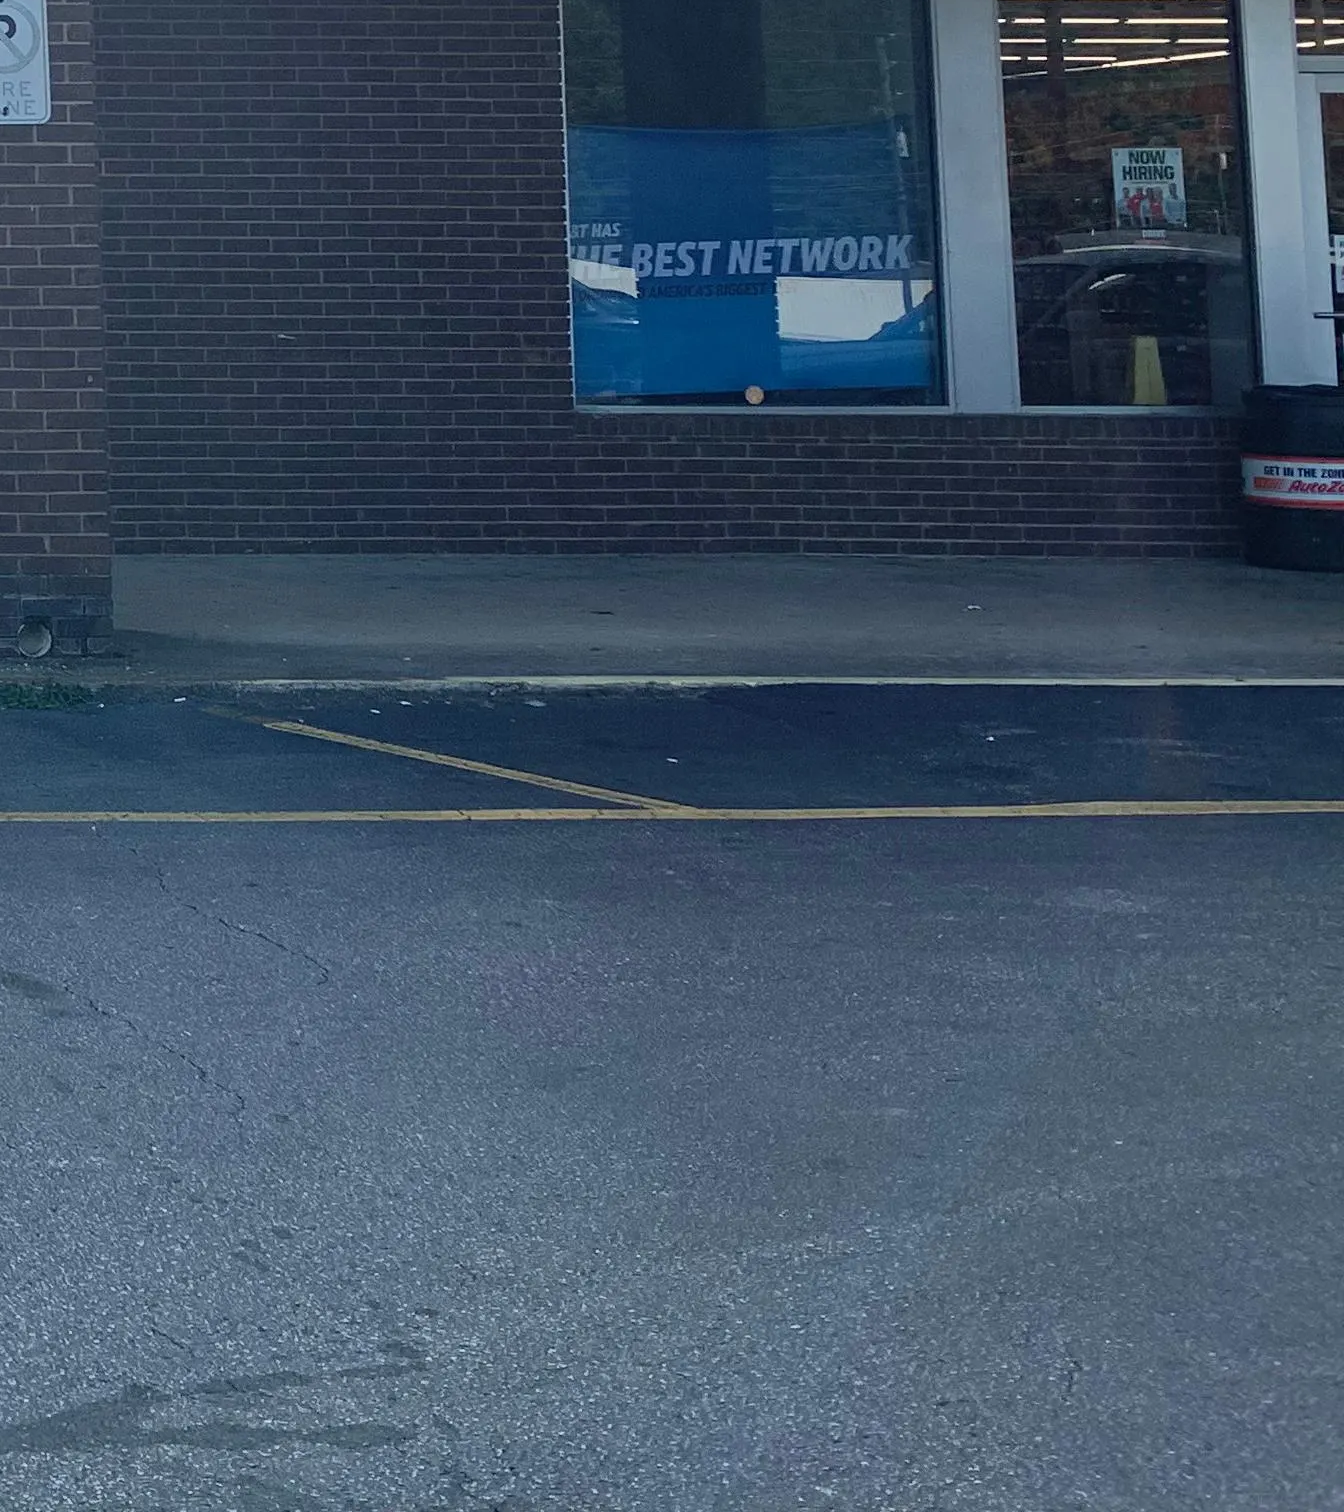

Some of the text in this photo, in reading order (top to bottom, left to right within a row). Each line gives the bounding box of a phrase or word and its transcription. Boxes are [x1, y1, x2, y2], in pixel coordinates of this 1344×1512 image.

[1128, 149, 1166, 165] NOW
[1122, 165, 1175, 181] HIRING
[591, 223, 622, 238] HAS
[631, 240, 722, 279] BEST
[727, 234, 913, 276] NETWORK
[1297, 467, 1317, 478] THE
